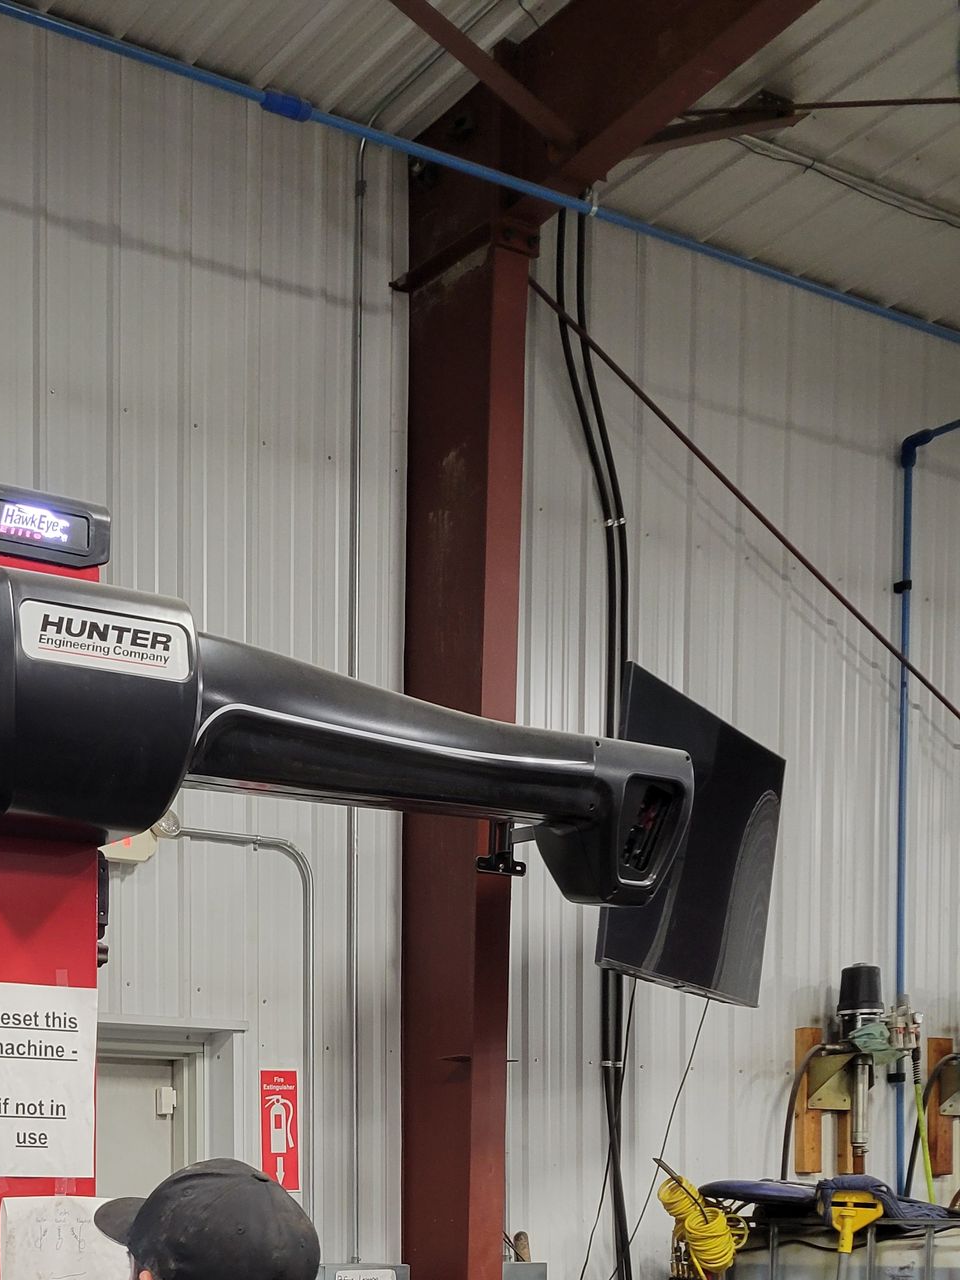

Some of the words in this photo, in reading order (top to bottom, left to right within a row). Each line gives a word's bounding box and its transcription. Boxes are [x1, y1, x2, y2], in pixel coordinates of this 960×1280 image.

[4, 507, 60, 532] HawkEye
[40, 613, 172, 652] HUNTER
[38, 633, 110, 656] Engineering
[113, 646, 170, 664] Company
[44, 1011, 79, 1030] this
[263, 1083, 295, 1091] Extinguisher
[15, 1099, 45, 1116] not
[50, 1099, 66, 1116] in
[15, 1129, 48, 1147] use
